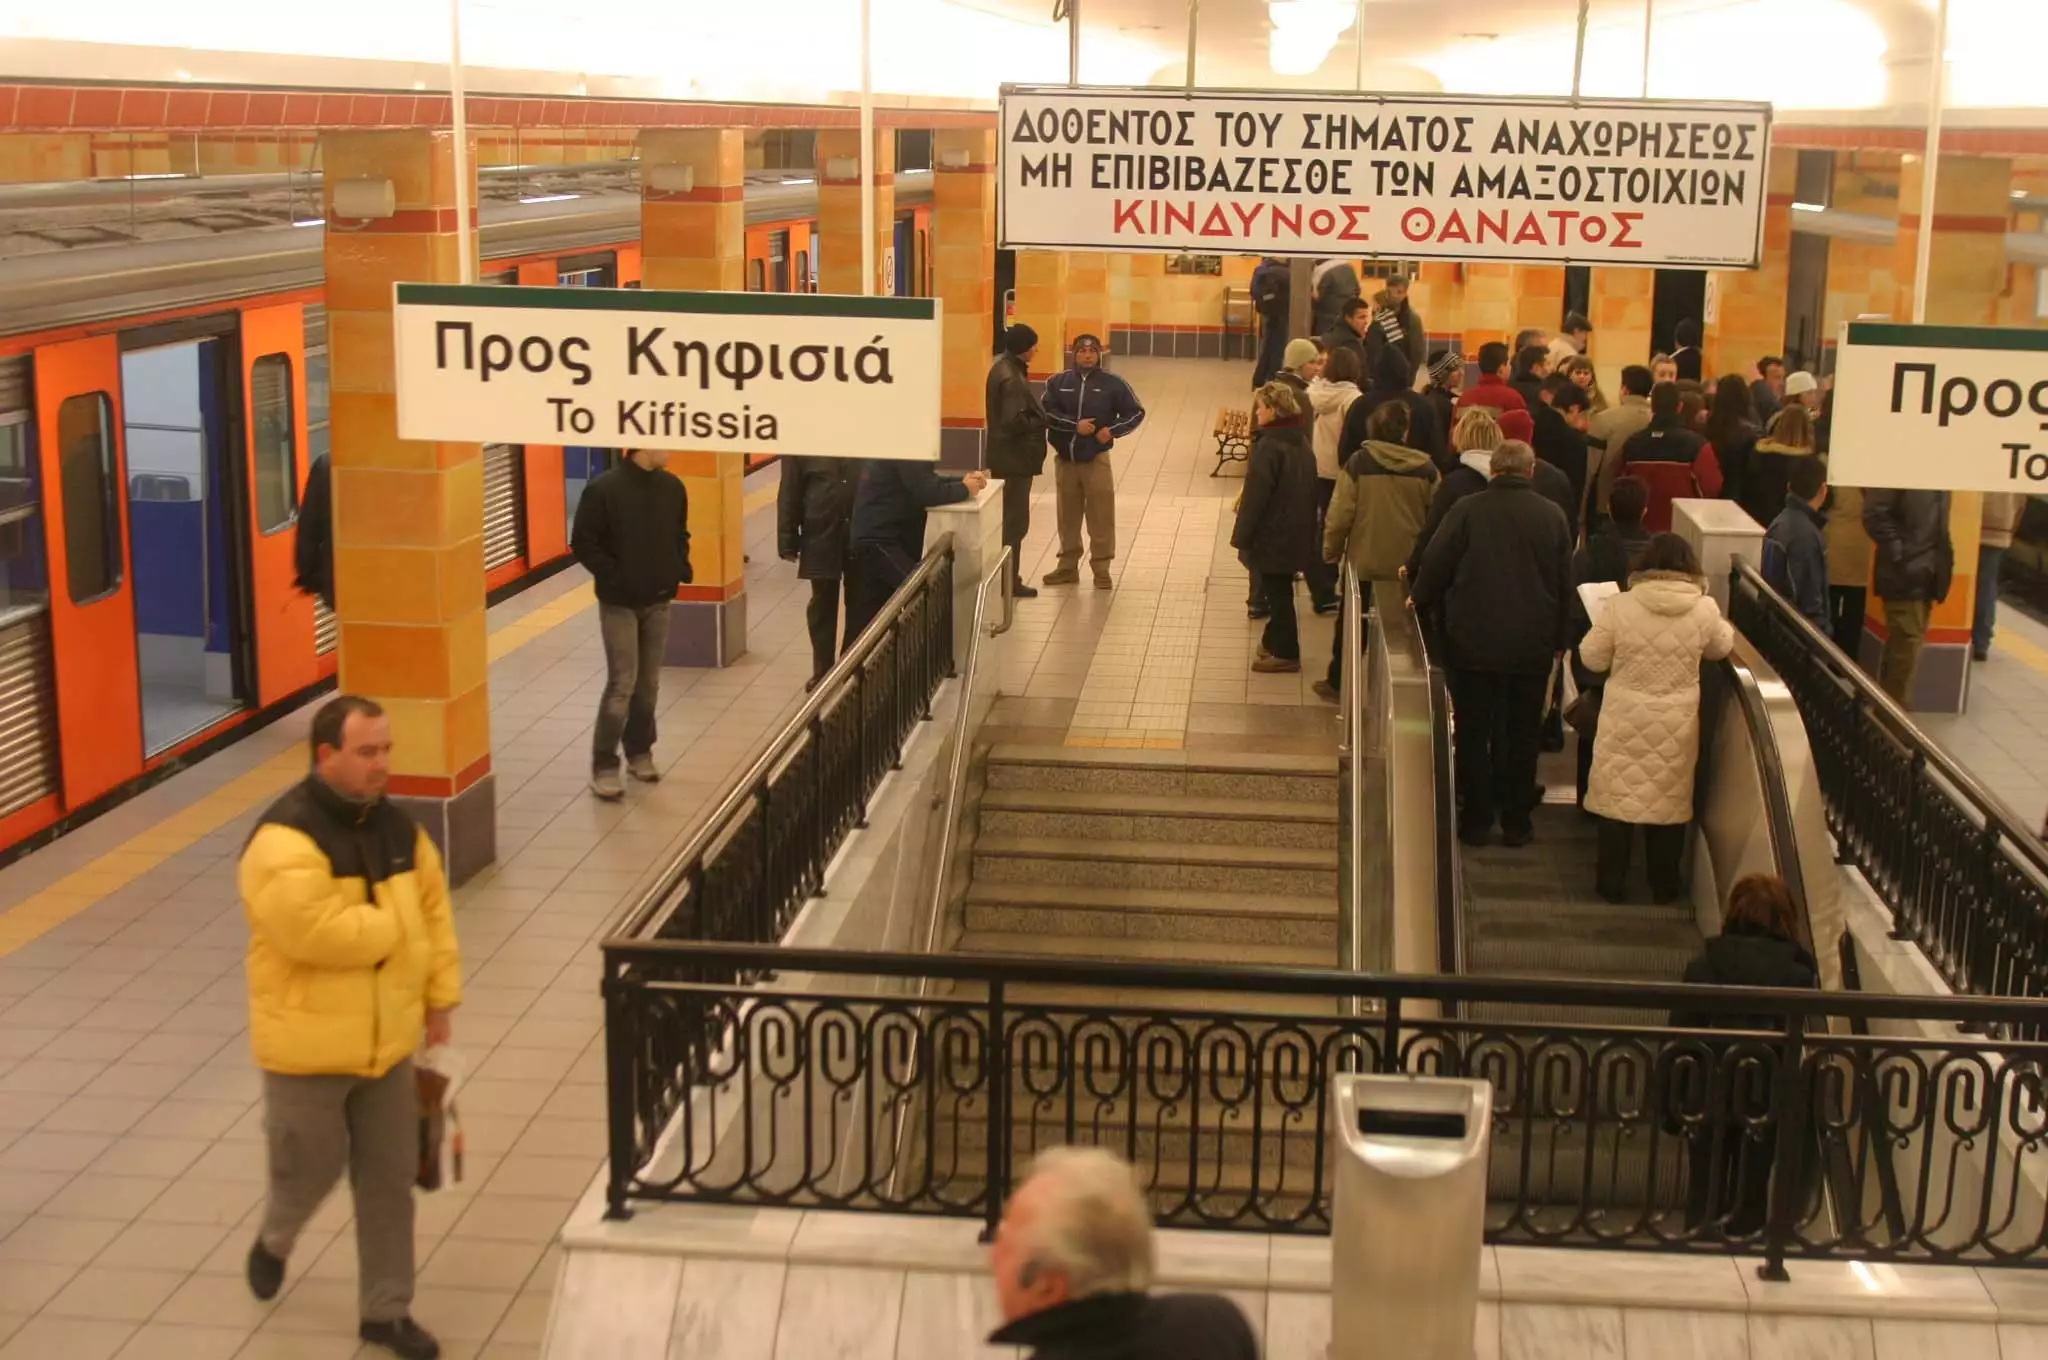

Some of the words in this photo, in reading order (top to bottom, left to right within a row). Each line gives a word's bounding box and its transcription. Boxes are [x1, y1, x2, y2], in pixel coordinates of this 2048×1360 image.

[1011, 107, 1196, 147] ΔΟΘΕΝΤΟΣ
[1214, 111, 1283, 149] ΤΟΥ
[1301, 113, 1474, 153] ΣΗΜΑΤΟΣ
[1490, 118, 1757, 161] ΑΝΑΧΩΡΗΣΕΩΣ
[1020, 152, 1073, 188] ΜΗ
[1091, 153, 1353, 196] ΕΠΙΒΙΒΑΖΕΣΘΕ
[1370, 160, 1435, 197] ΤΩΝ
[1449, 163, 1745, 206] ΑΜΑΞΟΣΤΟΙΧΙΩΝ
[1113, 198, 1371, 241] ΚΙΝΔΥΝΟΣ
[1400, 206, 1644, 248] ΘΑΝΑΤΟΣ
[435, 320, 592, 386] Προς
[627, 326, 894, 391] Κηφισιά
[546, 397, 595, 434] To
[617, 399, 778, 441] Kifissia
